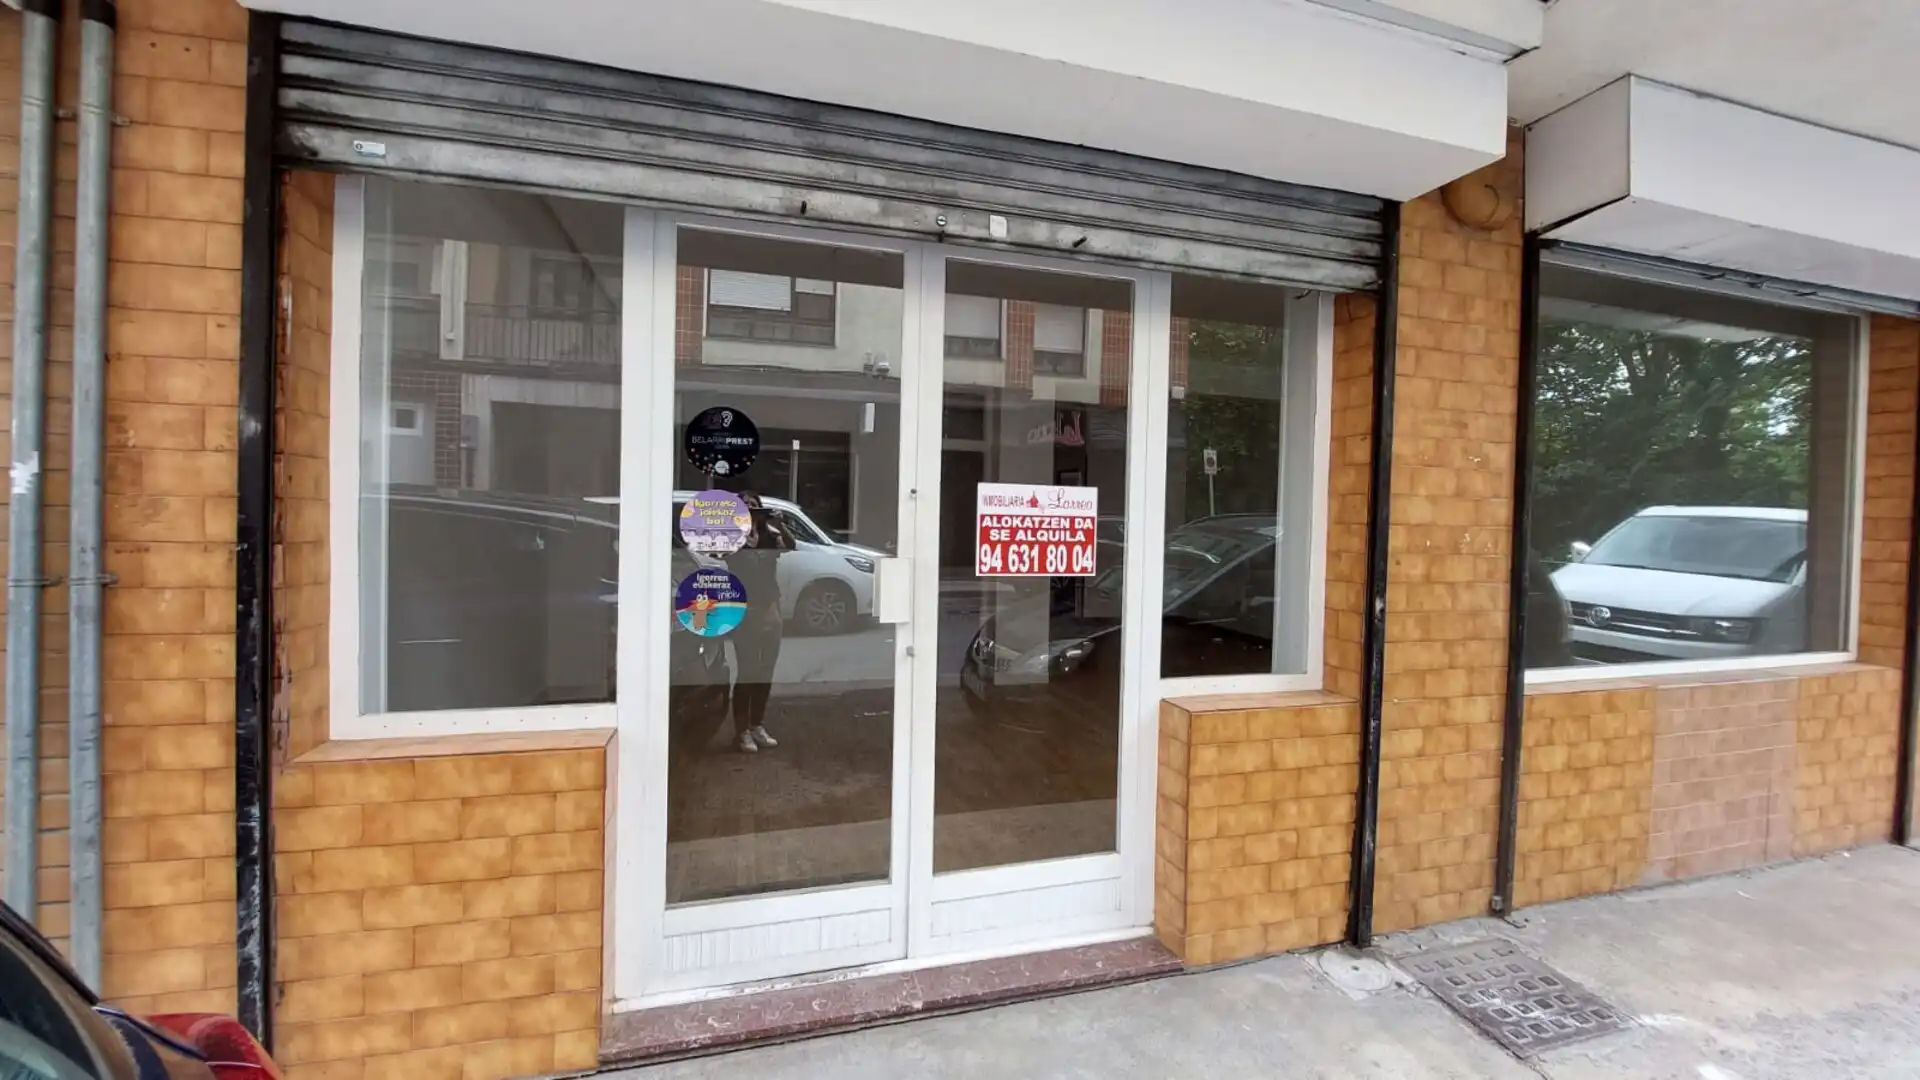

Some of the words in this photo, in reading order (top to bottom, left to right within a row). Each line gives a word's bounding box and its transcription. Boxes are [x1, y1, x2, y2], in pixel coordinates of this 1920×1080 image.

[983, 495, 1025, 507] INMOBILIARIA
[981, 516, 1070, 529] ALOKATZEN
[1074, 518, 1093, 529] DA
[989, 529, 1010, 541] SE
[1015, 530, 1086, 542] ALQUILA
[980, 544, 1002, 572] 94
[1007, 544, 1039, 572] 631
[1046, 544, 1067, 572] 80
[1072, 544, 1093, 572] 04
[696, 573, 729, 583] Igorren
